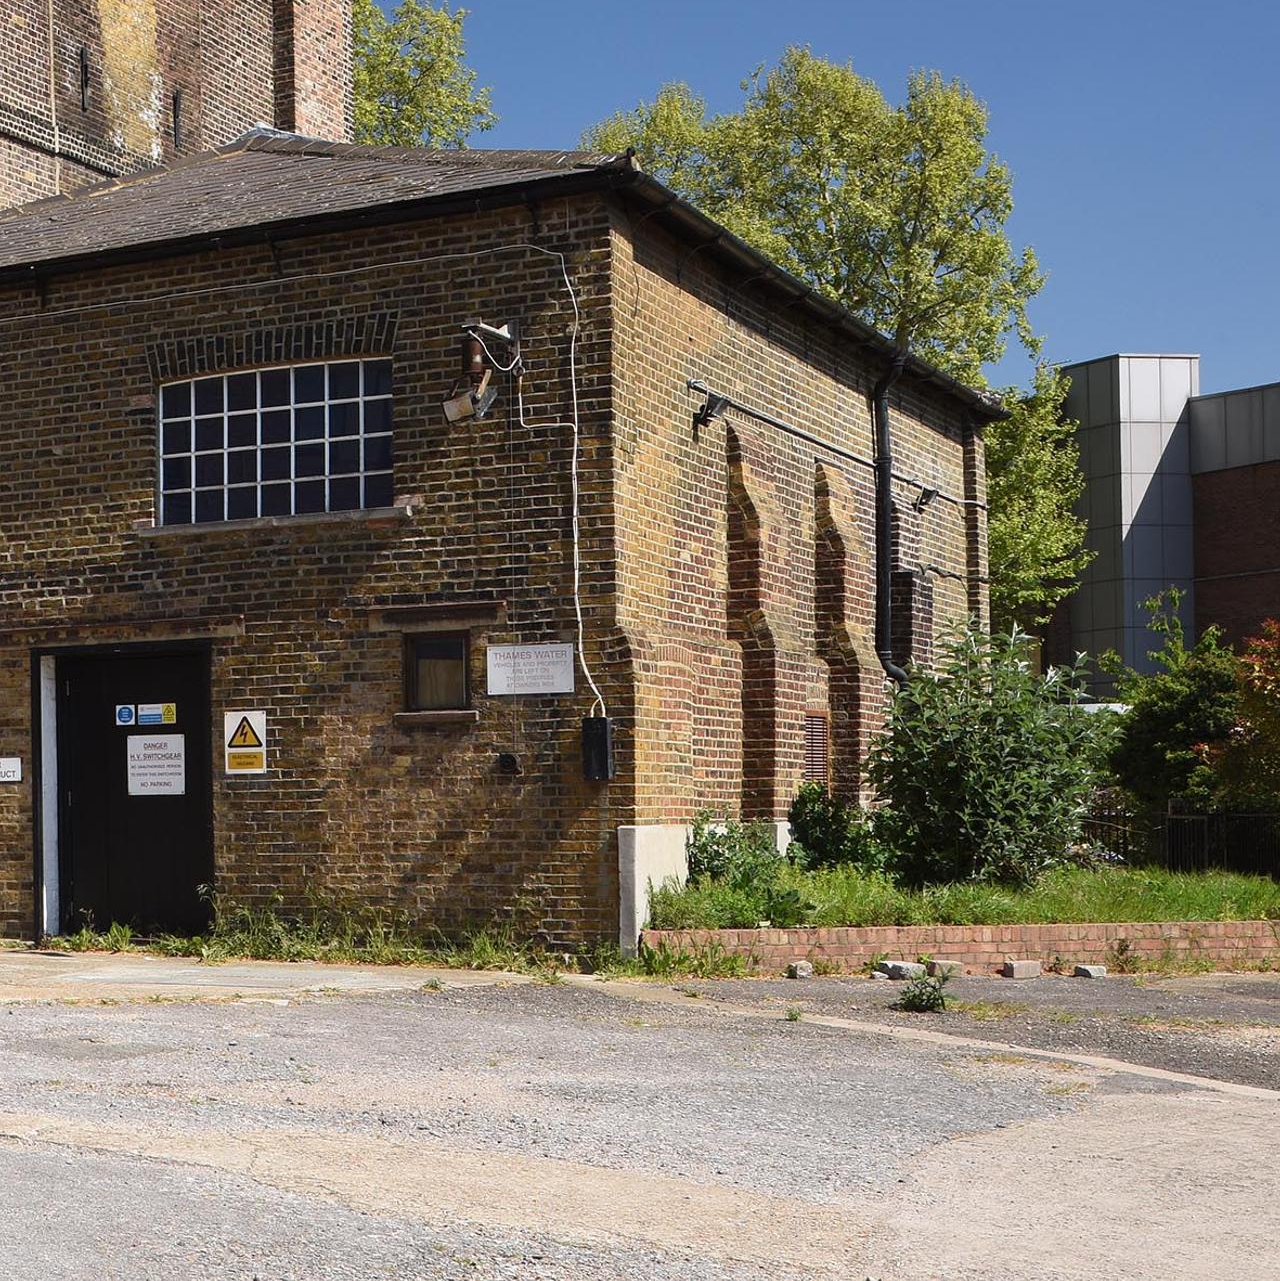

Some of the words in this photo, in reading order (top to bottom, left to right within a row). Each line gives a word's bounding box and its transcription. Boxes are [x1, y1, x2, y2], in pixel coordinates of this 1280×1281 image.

[493, 651, 532, 660] THAMES
[534, 650, 568, 659] WATER
[144, 742, 168, 751] DANGER
[143, 752, 182, 760] SWITCHGEAR
